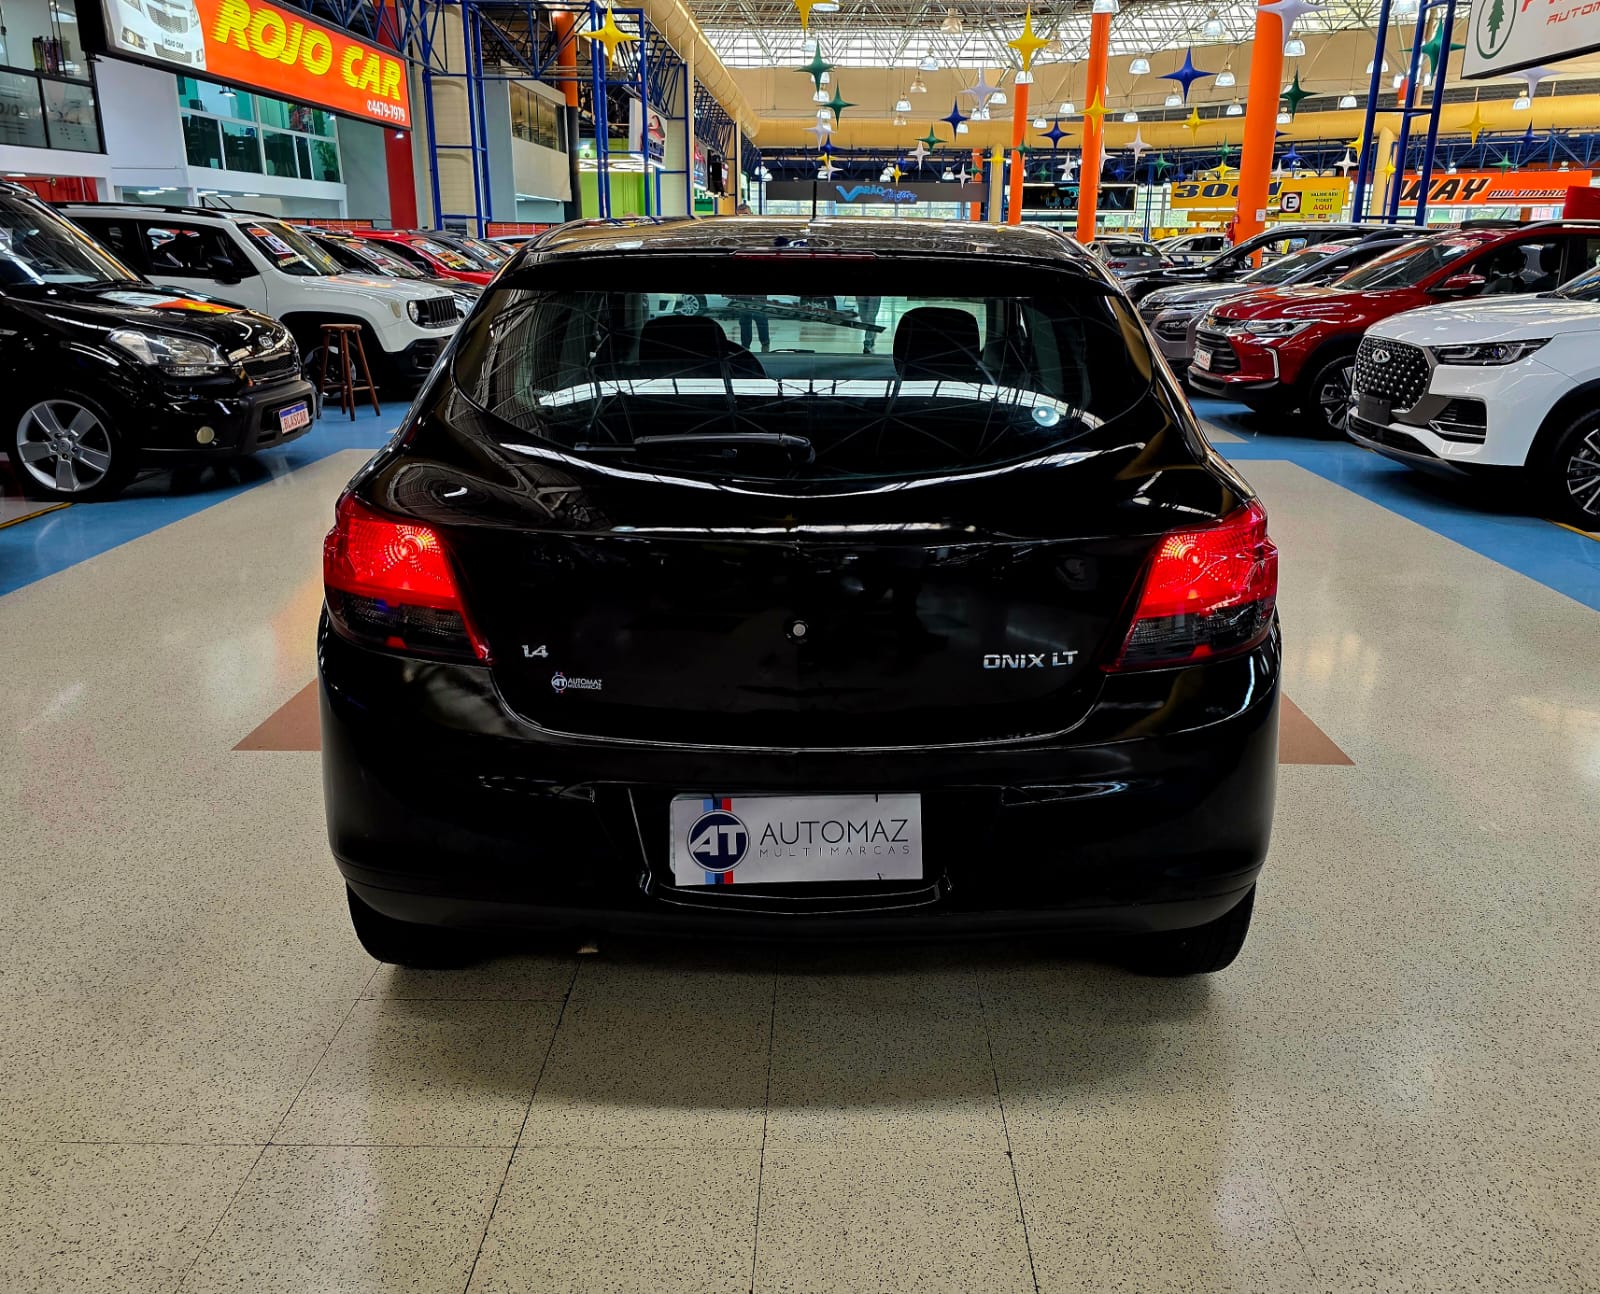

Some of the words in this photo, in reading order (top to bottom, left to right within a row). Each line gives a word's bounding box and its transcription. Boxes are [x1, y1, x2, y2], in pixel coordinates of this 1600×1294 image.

[211, 0, 333, 76] ROJO
[341, 45, 401, 101] CAR
[371, 101, 406, 122] 4479-7979
[1286, 196, 1297, 209] E
[283, 410, 307, 430] BLASCAR
[1052, 650, 1079, 667] LT
[759, 819, 909, 846] AUTOMAZ
[759, 845, 911, 858] MULTIMARCAS
